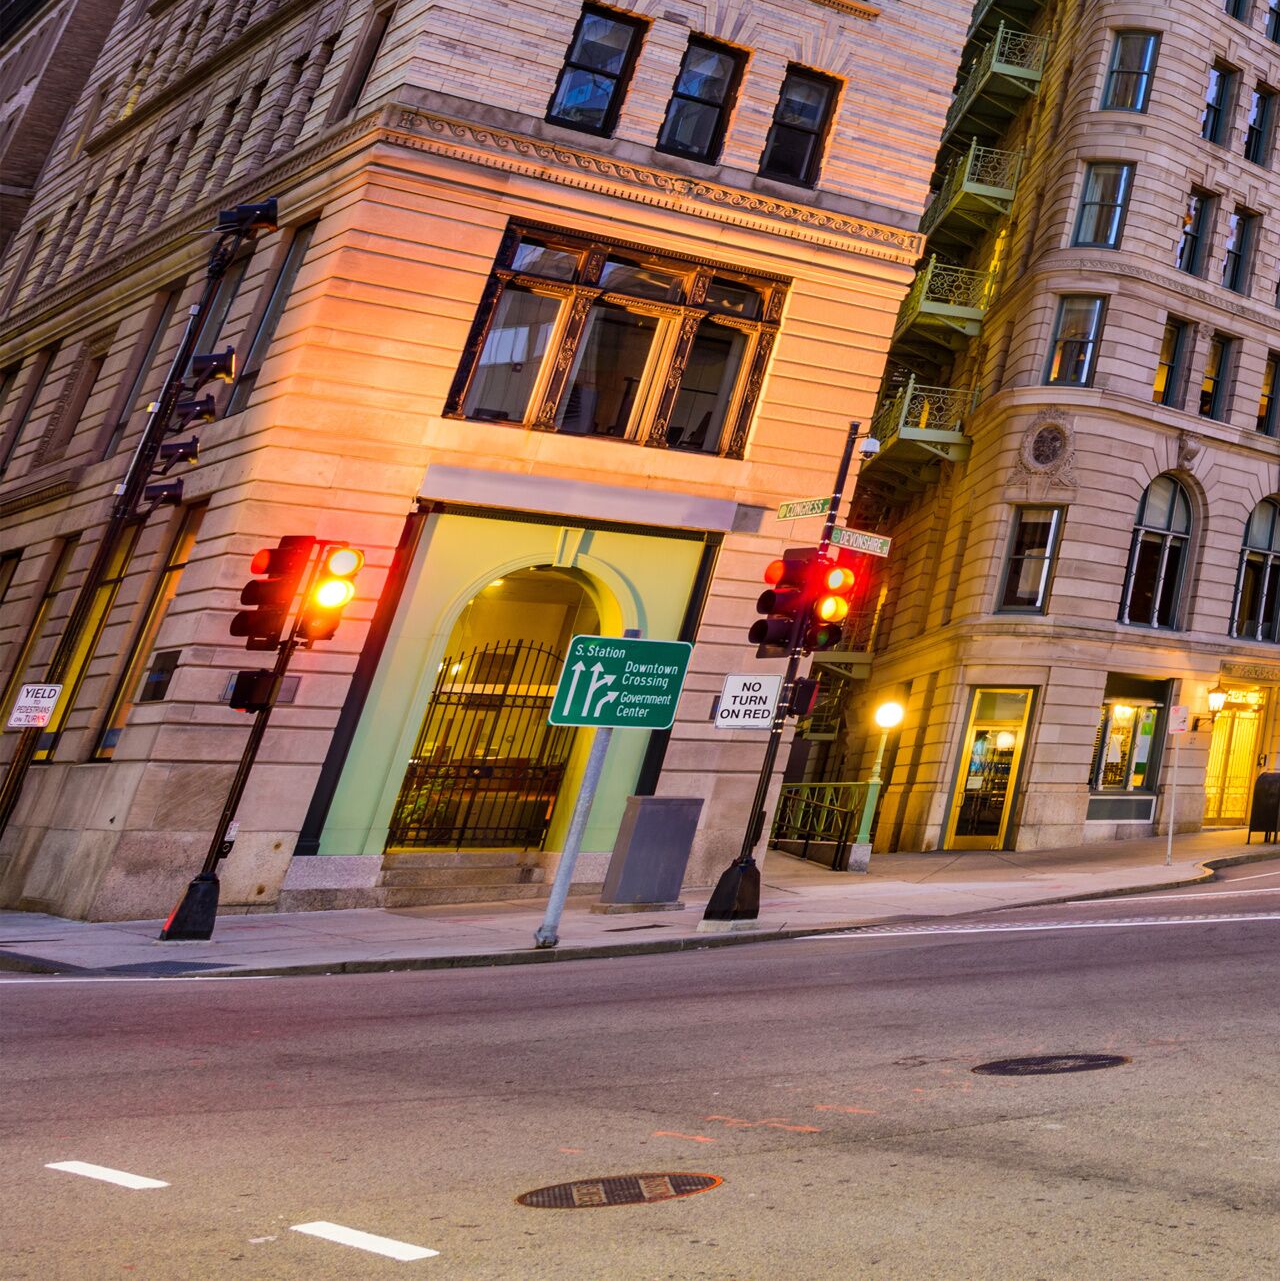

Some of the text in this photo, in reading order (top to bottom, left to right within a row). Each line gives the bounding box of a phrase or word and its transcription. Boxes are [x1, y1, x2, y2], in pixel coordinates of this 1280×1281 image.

[786, 501, 823, 517] CONGRESS
[840, 531, 884, 552] DEVONSHIRE
[575, 644, 626, 658] S. Station
[625, 661, 678, 675] Downtown
[622, 674, 669, 690] Crossing
[742, 682, 762, 692] NO
[26, 688, 57, 699] YIELD
[620, 692, 672, 705] Government
[732, 695, 768, 705] TURN
[616, 705, 650, 718] Center
[720, 709, 770, 719] ON RED
